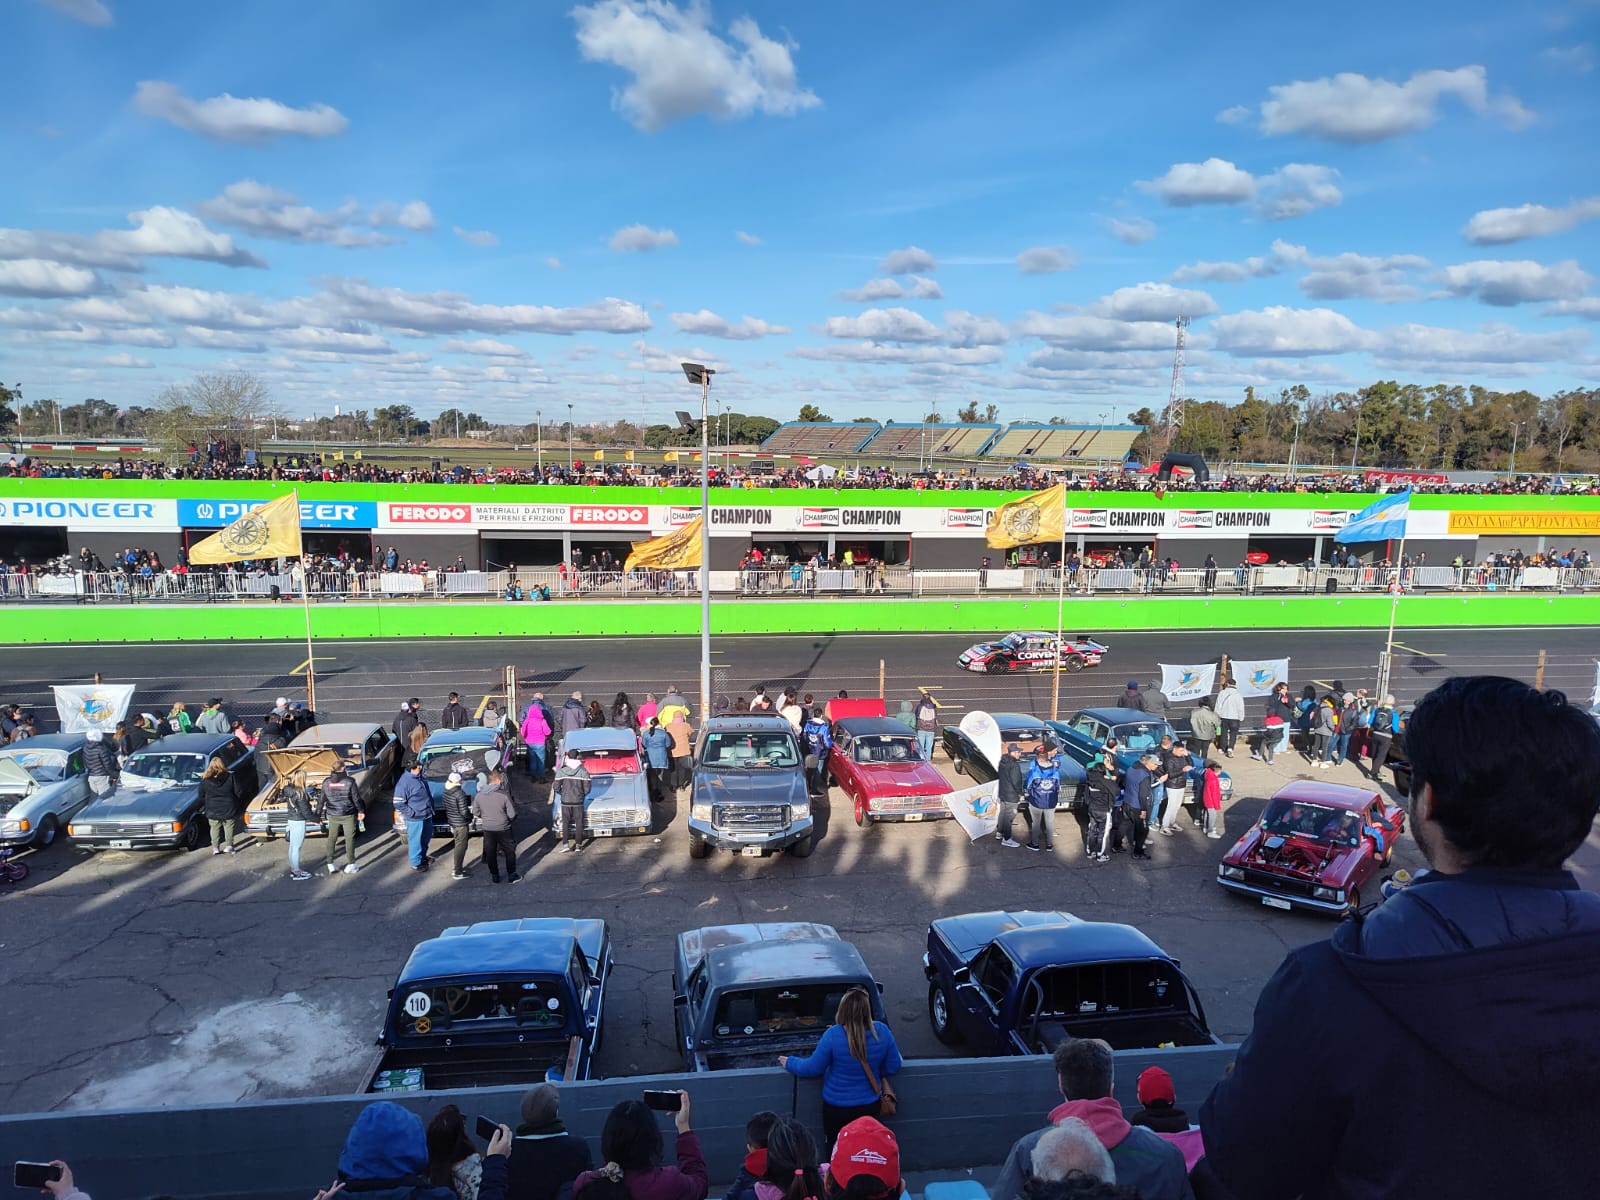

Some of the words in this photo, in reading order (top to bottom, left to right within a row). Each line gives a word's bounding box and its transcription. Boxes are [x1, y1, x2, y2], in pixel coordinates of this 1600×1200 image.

[13, 502, 154, 518] PIONEER
[219, 503, 356, 520] PIEER
[391, 507, 466, 520] FERODO
[572, 509, 643, 522] FERODO
[711, 508, 772, 525] CHAMPION
[842, 509, 901, 525] CHAMPION
[949, 514, 982, 522] CHAMPION
[1109, 511, 1165, 527] CHAMPION
[1215, 511, 1270, 527] CHAMPION
[1315, 516, 1345, 524] CHAMPION
[409, 998, 426, 1012] 110
